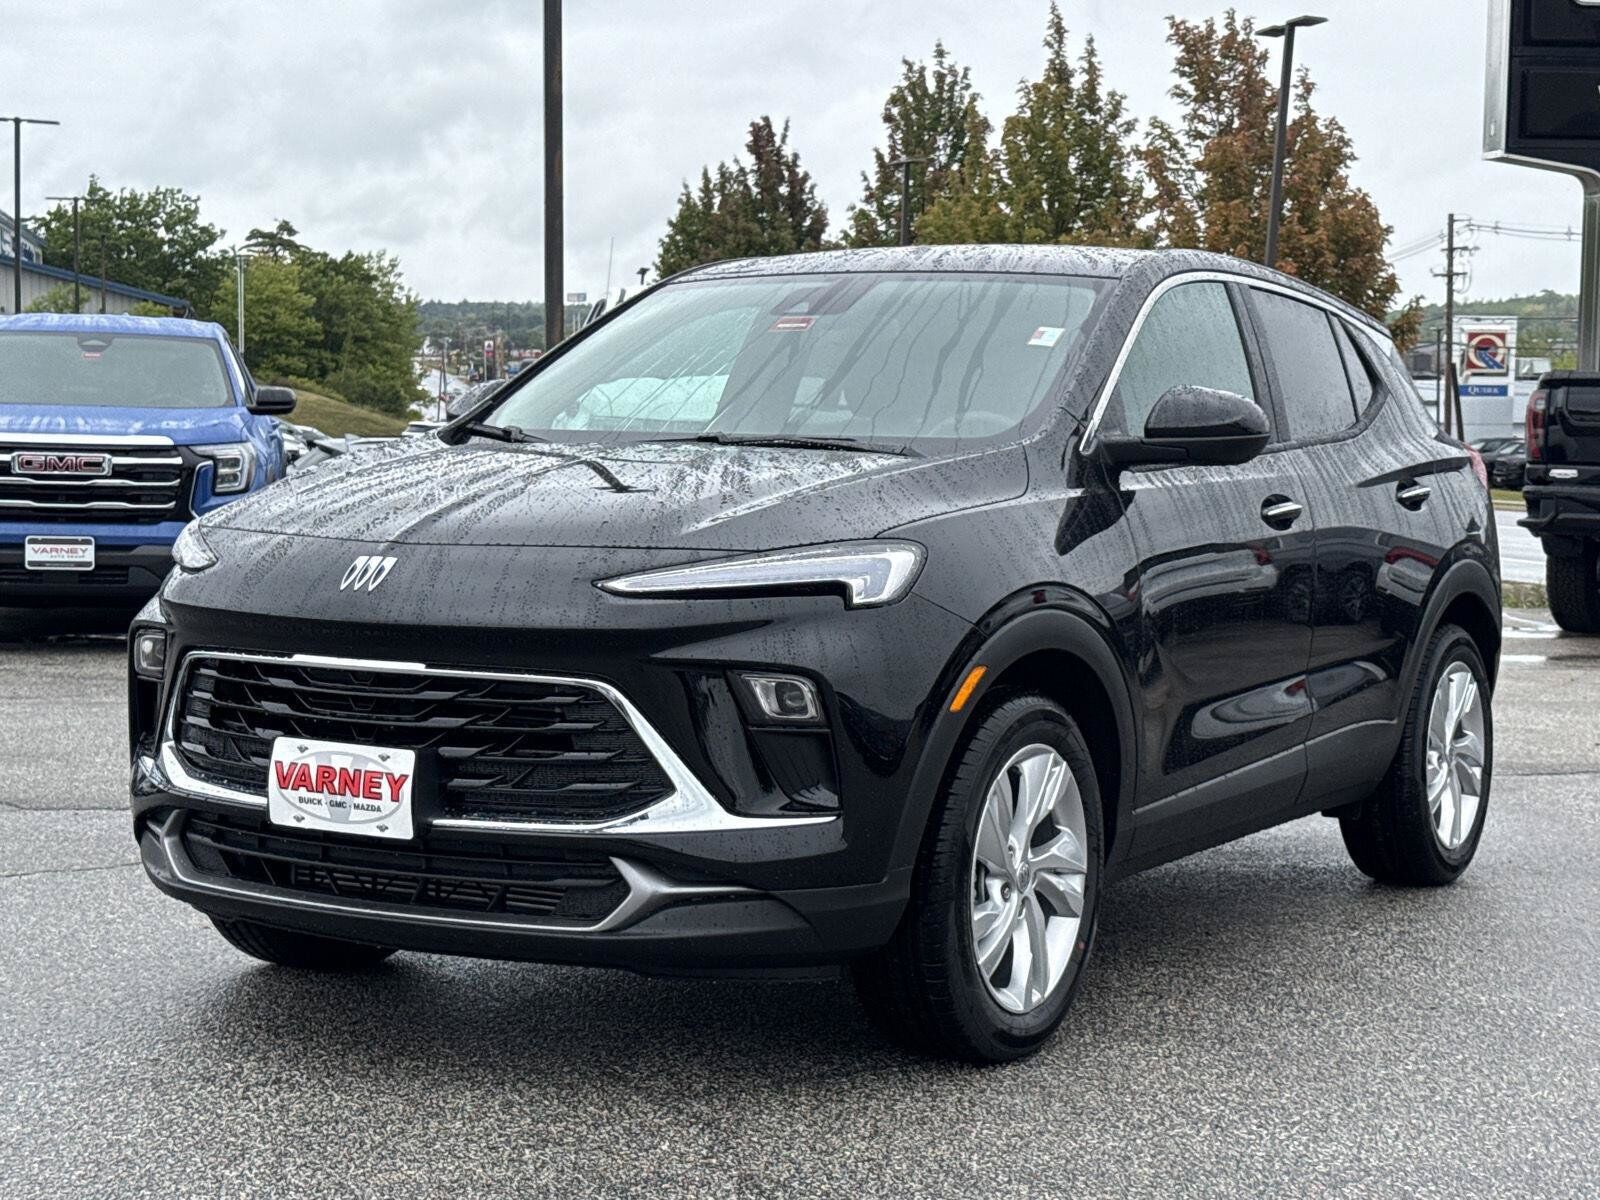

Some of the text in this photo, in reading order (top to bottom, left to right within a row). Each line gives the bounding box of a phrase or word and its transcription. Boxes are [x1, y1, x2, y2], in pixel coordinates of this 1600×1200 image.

[19, 455, 104, 472] GMC
[31, 547, 89, 555] VARNEY
[274, 760, 410, 803] VARNEY
[298, 796, 382, 813] BUICK GMC MAZDA
